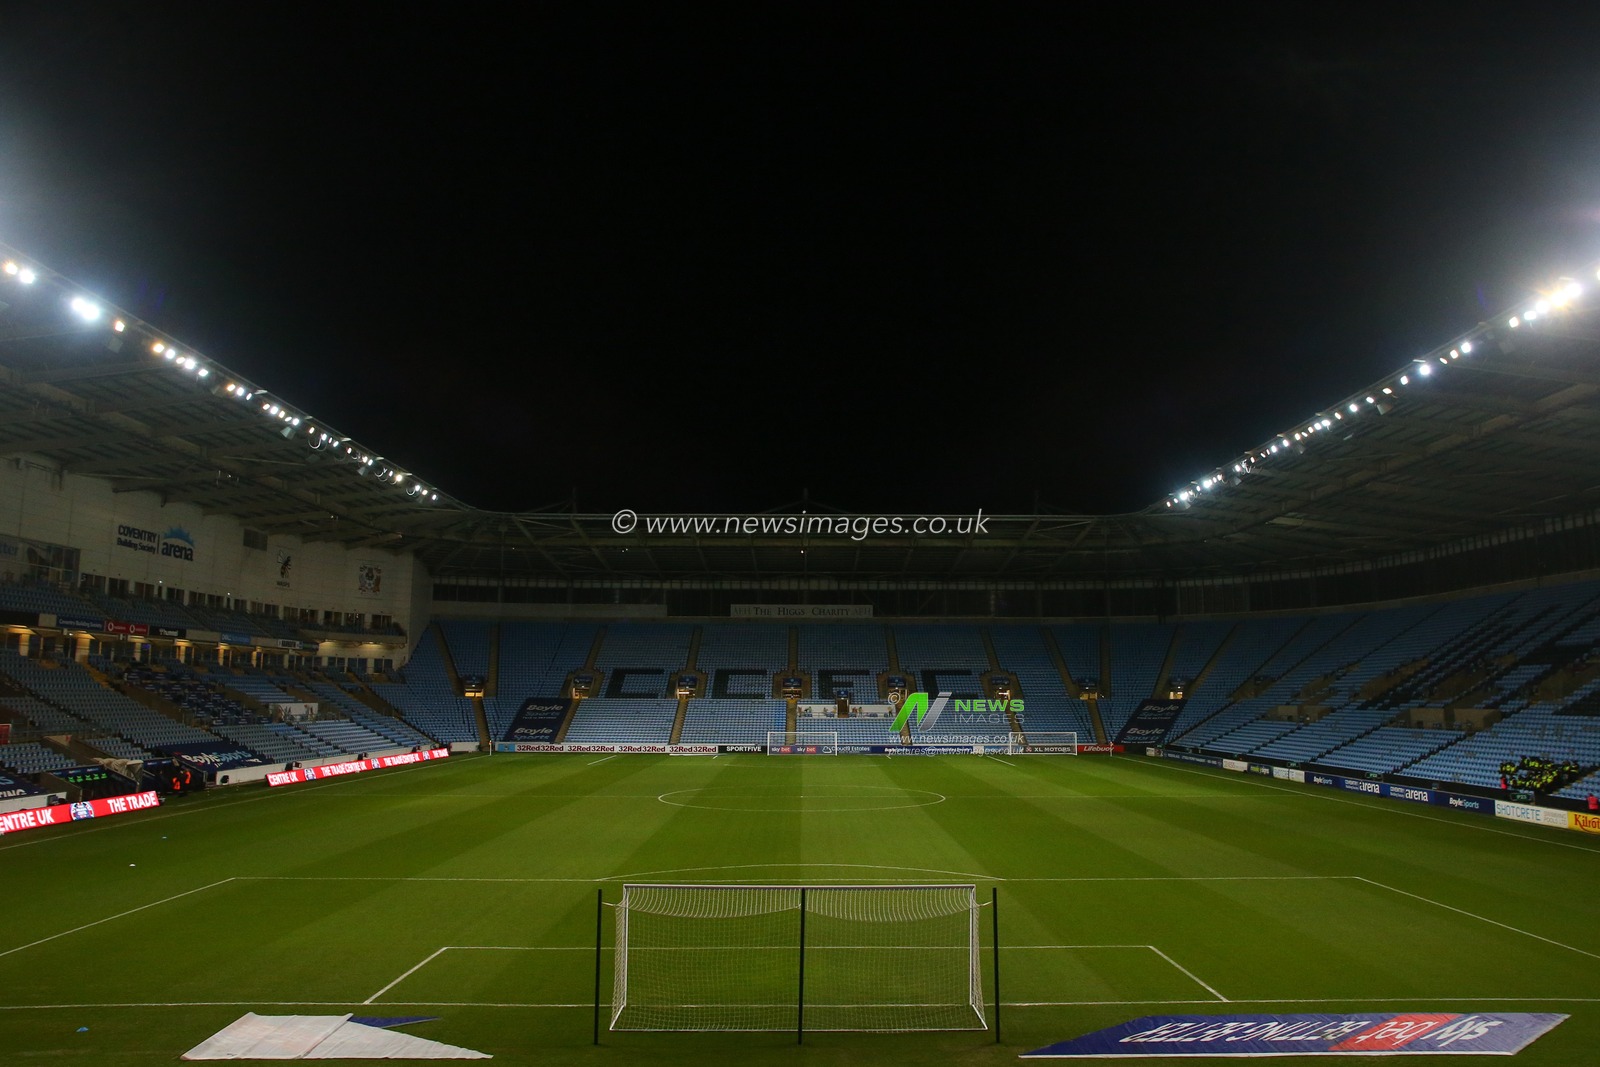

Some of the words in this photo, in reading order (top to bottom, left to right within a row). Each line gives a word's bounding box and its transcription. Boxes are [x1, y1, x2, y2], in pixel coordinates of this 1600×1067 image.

[118, 525, 157, 543] COVENTRY
[116, 537, 138, 552] Building
[138, 542, 156, 555] Society
[162, 542, 193, 562] arena
[778, 607, 805, 616] HIGGS
[812, 606, 849, 616] CHARITY
[1142, 704, 1179, 712] Boyle
[1126, 728, 1165, 736] Boyle
[268, 772, 290, 786] CENTRE
[1359, 780, 1380, 794] arena
[1406, 788, 1428, 802] arena
[107, 798, 128, 814] THE
[127, 792, 157, 812] TRADE
[1449, 797, 1479, 809] BoyleSports
[36, 808, 54, 825] UK
[1496, 804, 1540, 821] SHOTCRETE
